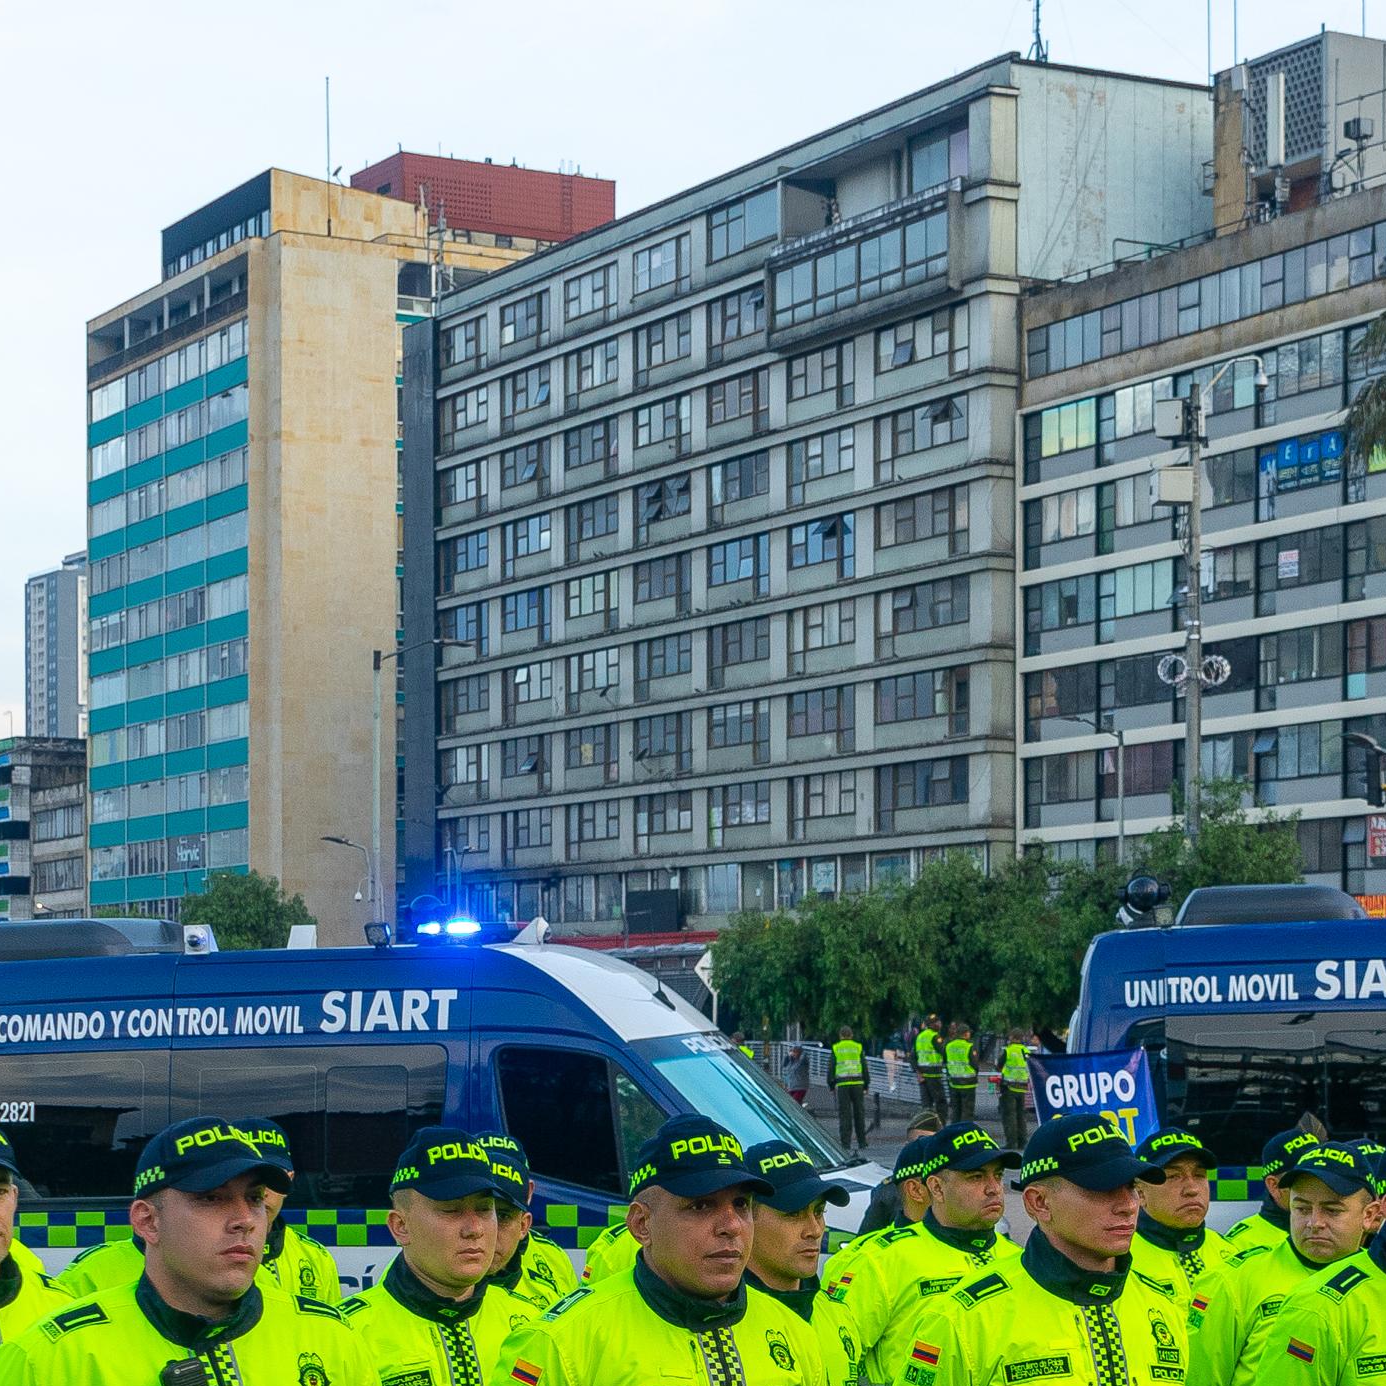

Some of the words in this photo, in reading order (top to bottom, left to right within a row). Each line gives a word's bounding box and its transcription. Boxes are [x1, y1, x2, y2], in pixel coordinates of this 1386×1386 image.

[1228, 973, 1299, 1002] MOVIL
[110, 1010, 125, 1038] Y
[127, 1006, 229, 1038] CONTROL
[234, 1005, 304, 1034] MOVIL
[319, 989, 458, 1034] SIART
[1045, 1069, 1136, 1108] GRUPO
